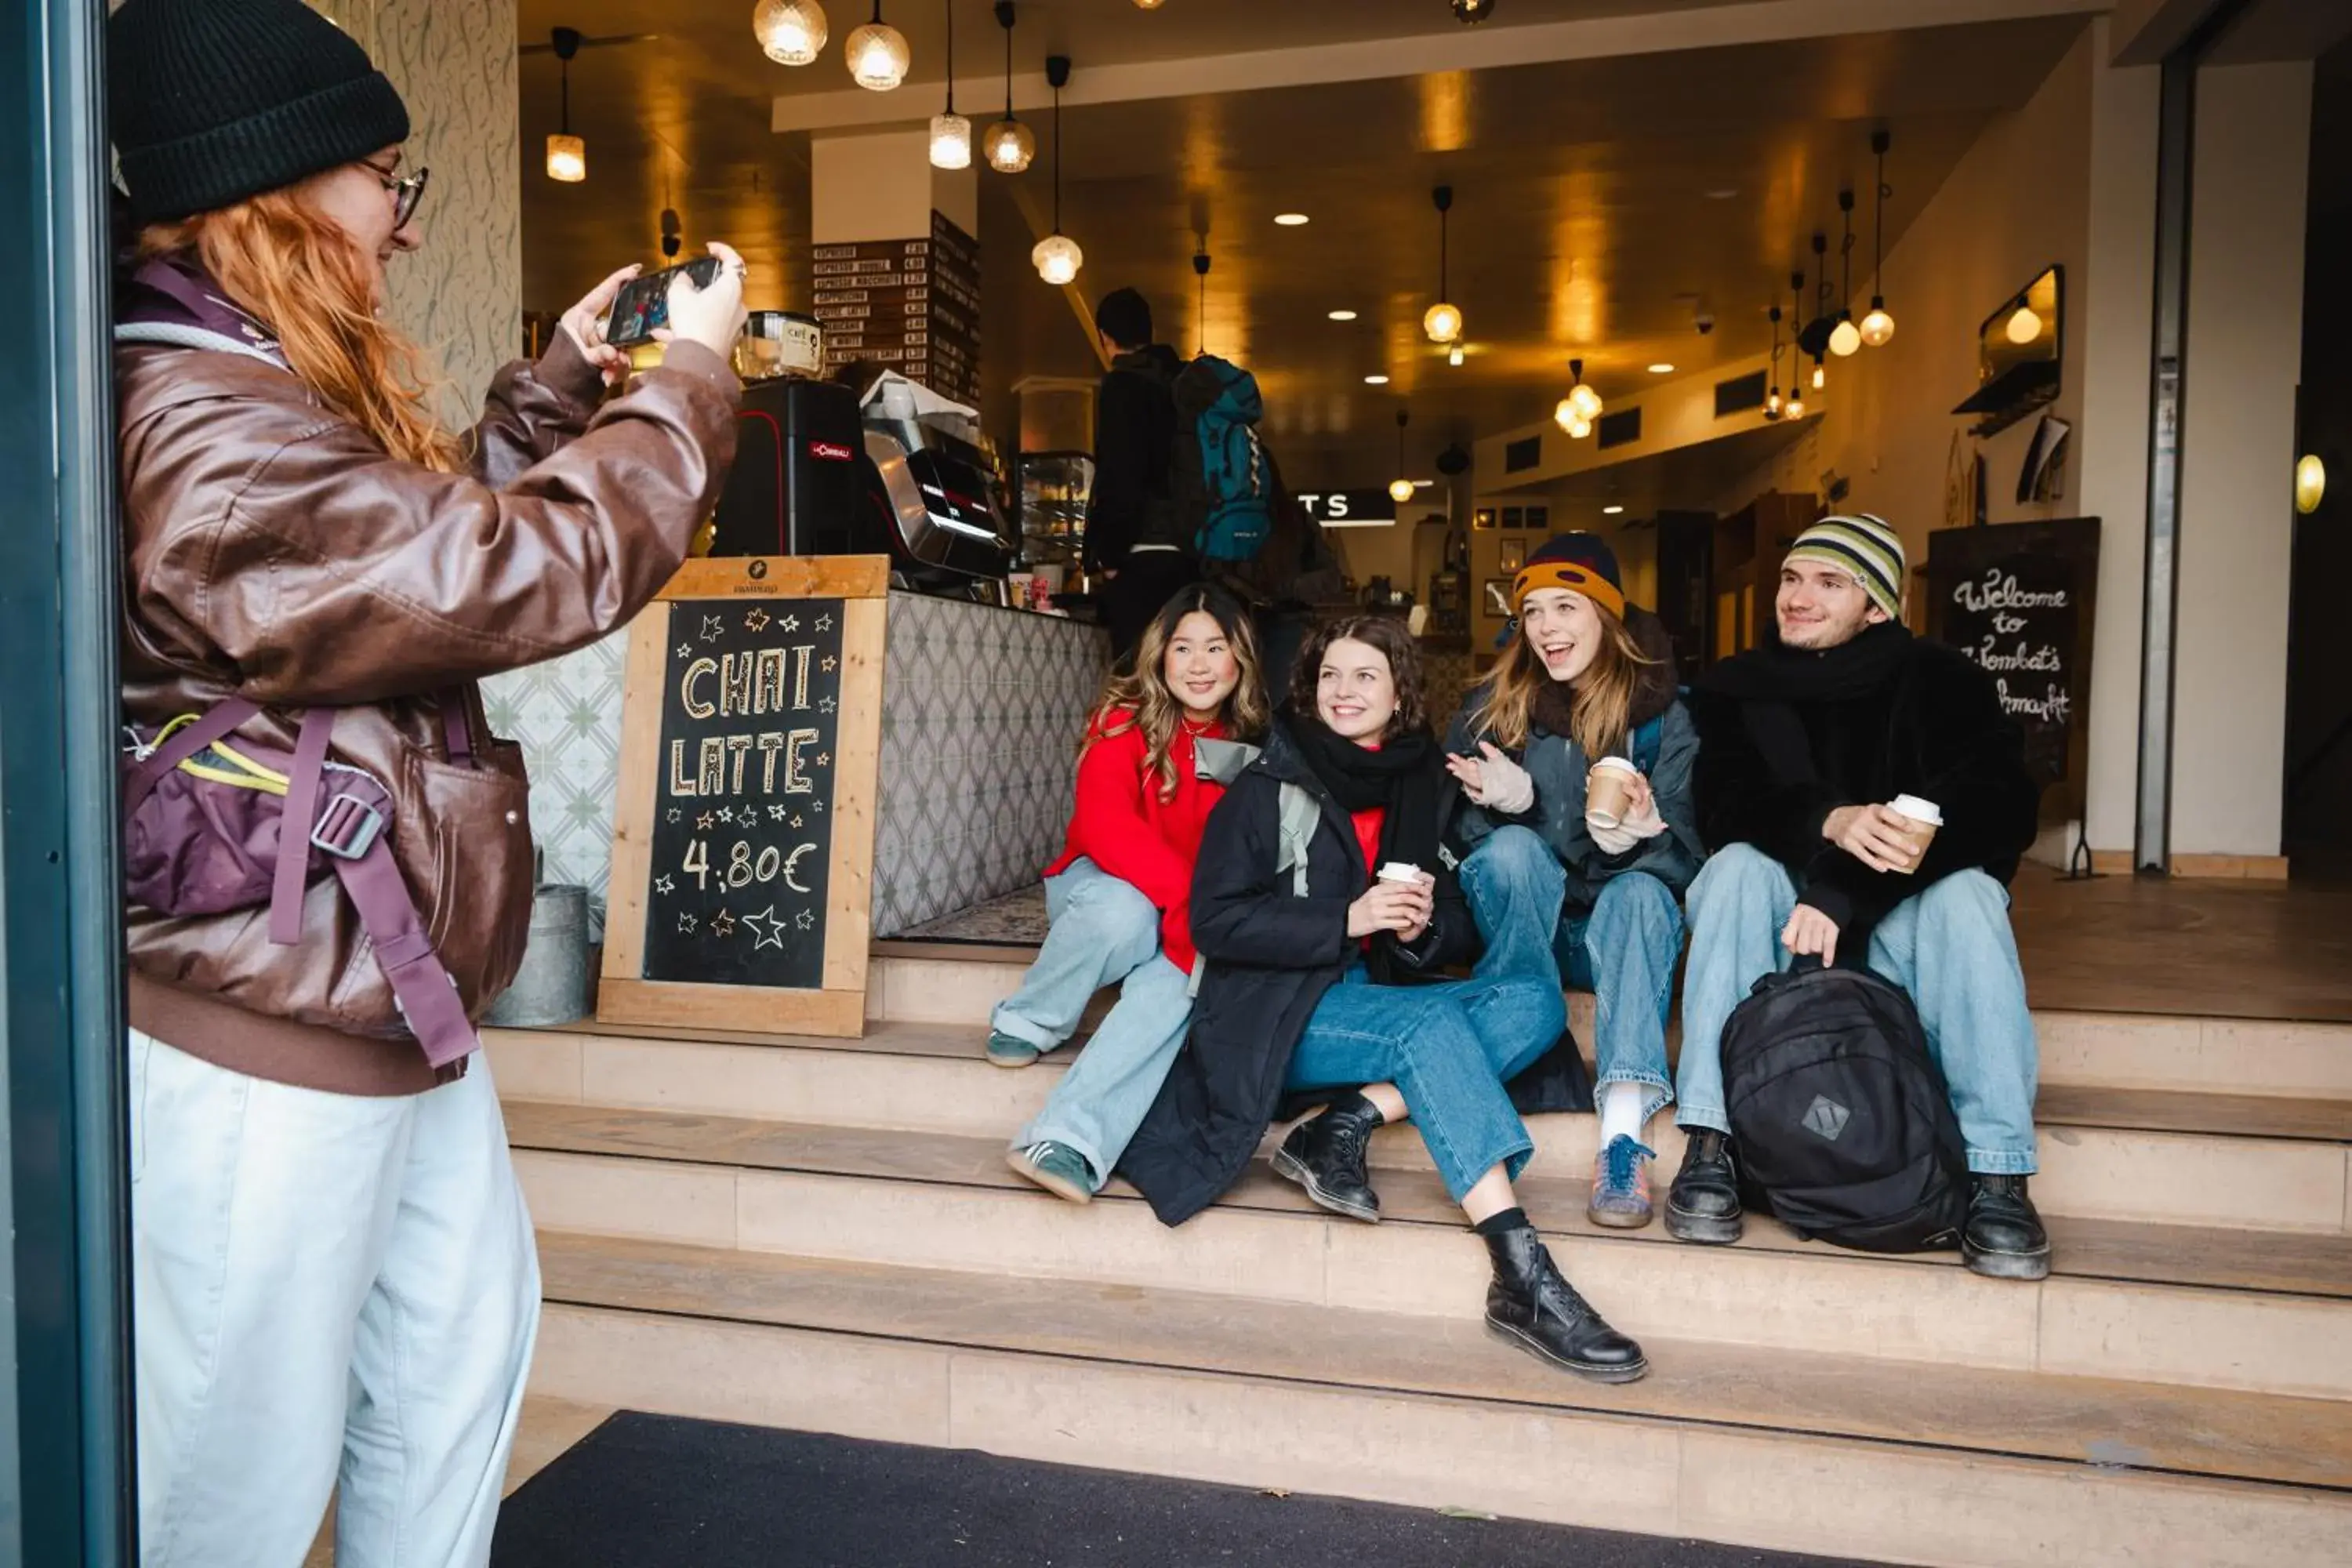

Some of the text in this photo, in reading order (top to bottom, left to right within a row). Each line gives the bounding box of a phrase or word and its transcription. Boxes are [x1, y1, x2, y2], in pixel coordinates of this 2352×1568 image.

[1953, 568, 2068, 612] Welcome
[1991, 612, 2028, 633] to
[681, 644, 816, 719] CHAI
[1996, 678, 2071, 724] hmarkt
[670, 728, 819, 797] LATTE
